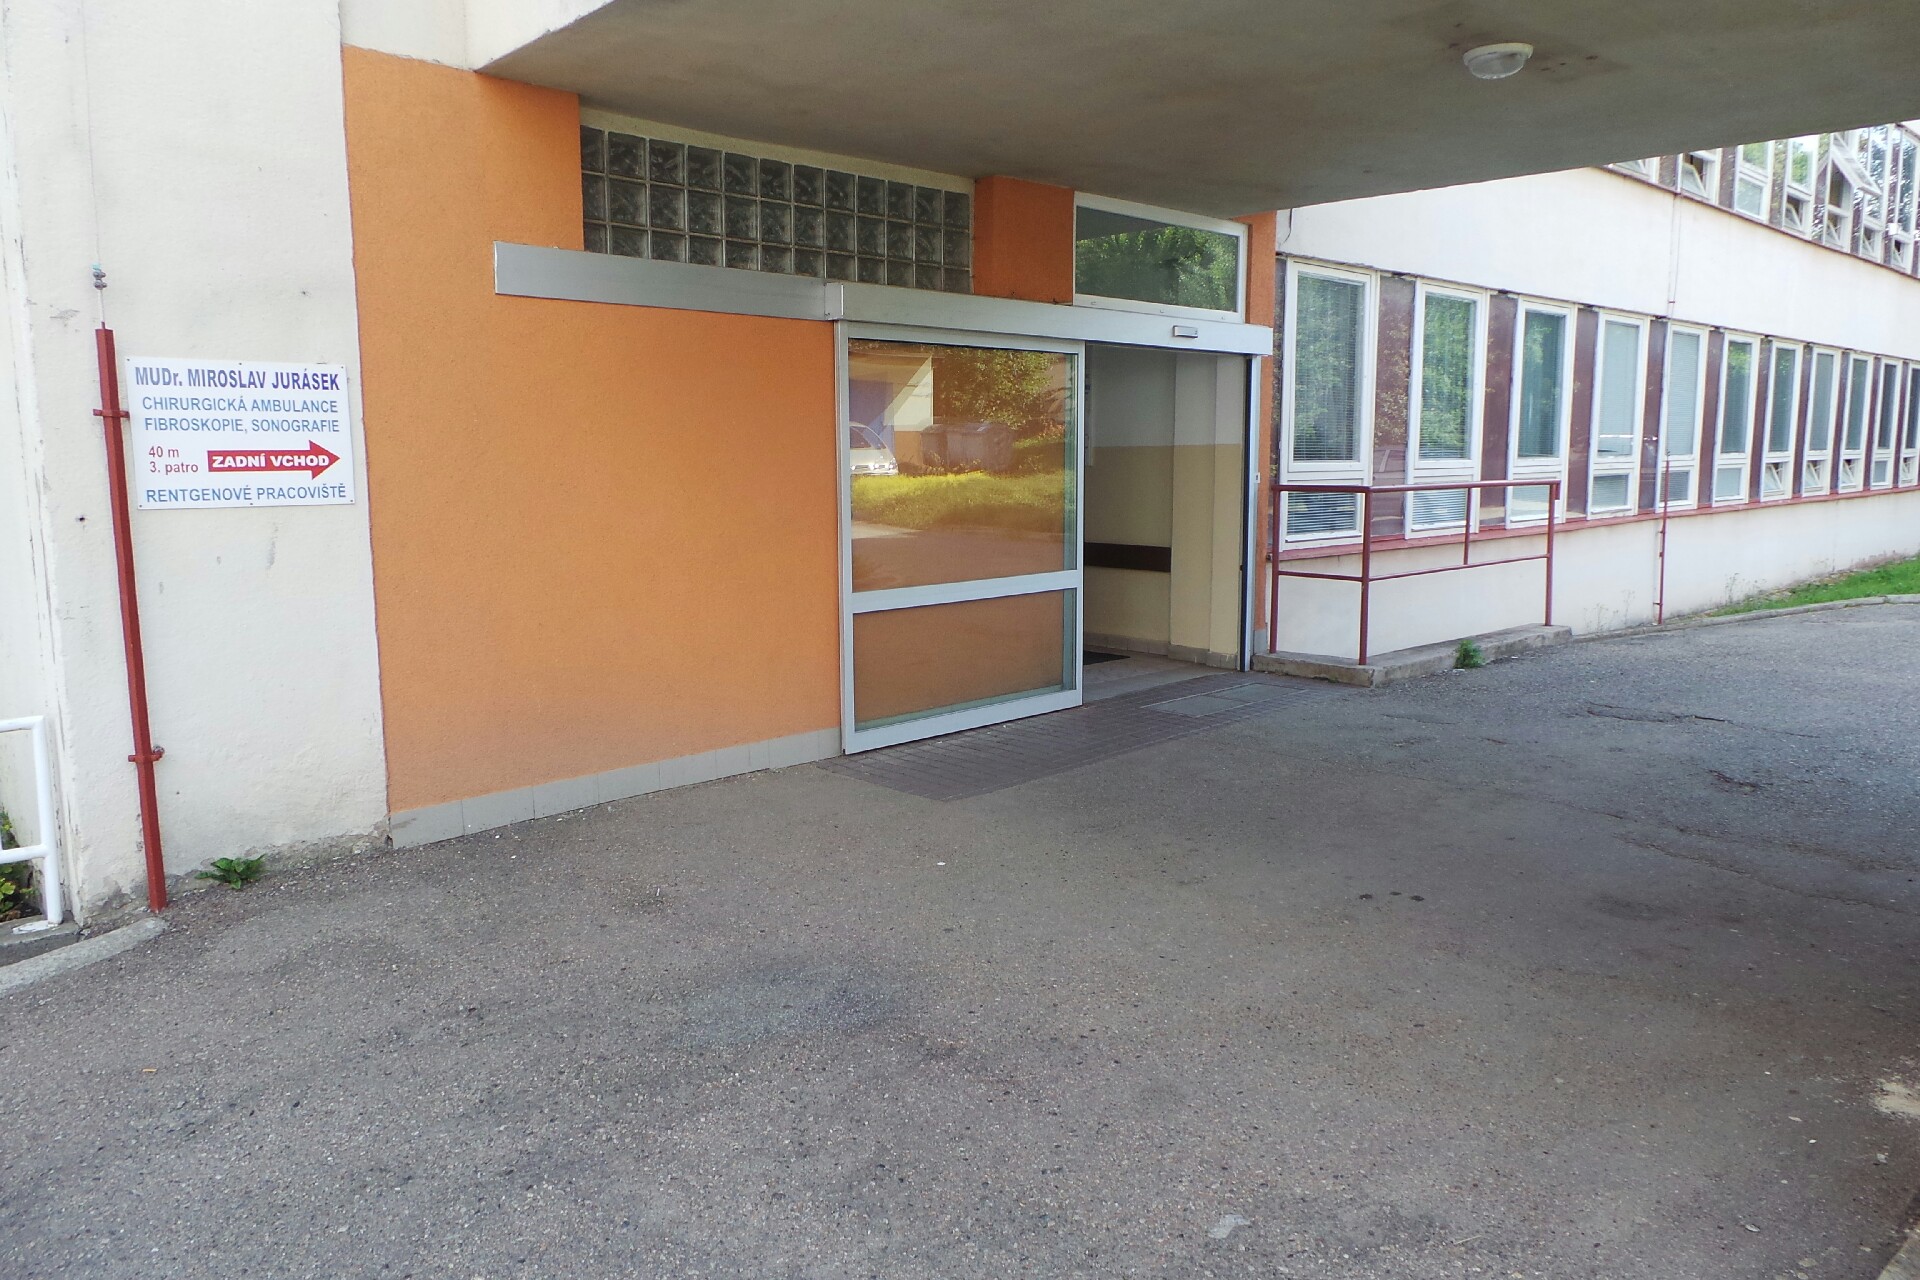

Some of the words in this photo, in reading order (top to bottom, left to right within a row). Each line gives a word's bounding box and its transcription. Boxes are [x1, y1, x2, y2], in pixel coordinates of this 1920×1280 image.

[135, 367, 182, 386] MUDr.
[187, 368, 266, 389] MIROSLAV
[272, 369, 340, 390] JURÁSEK
[142, 396, 247, 411] CHIRURGICKÁ
[251, 399, 338, 413] AMBULANCE
[145, 418, 248, 433] FIBROSKOPIE,
[252, 419, 339, 432] SONOGRAFIE
[149, 446, 163, 458] 40
[168, 449, 179, 458] m
[150, 461, 161, 473] 3.
[165, 462, 198, 475] patro
[212, 454, 265, 468] ZADNÍ
[270, 455, 329, 466] VCHOD
[146, 485, 251, 502] RENTGENOVÉ
[257, 483, 346, 499] PRACOVIŠTĚ
